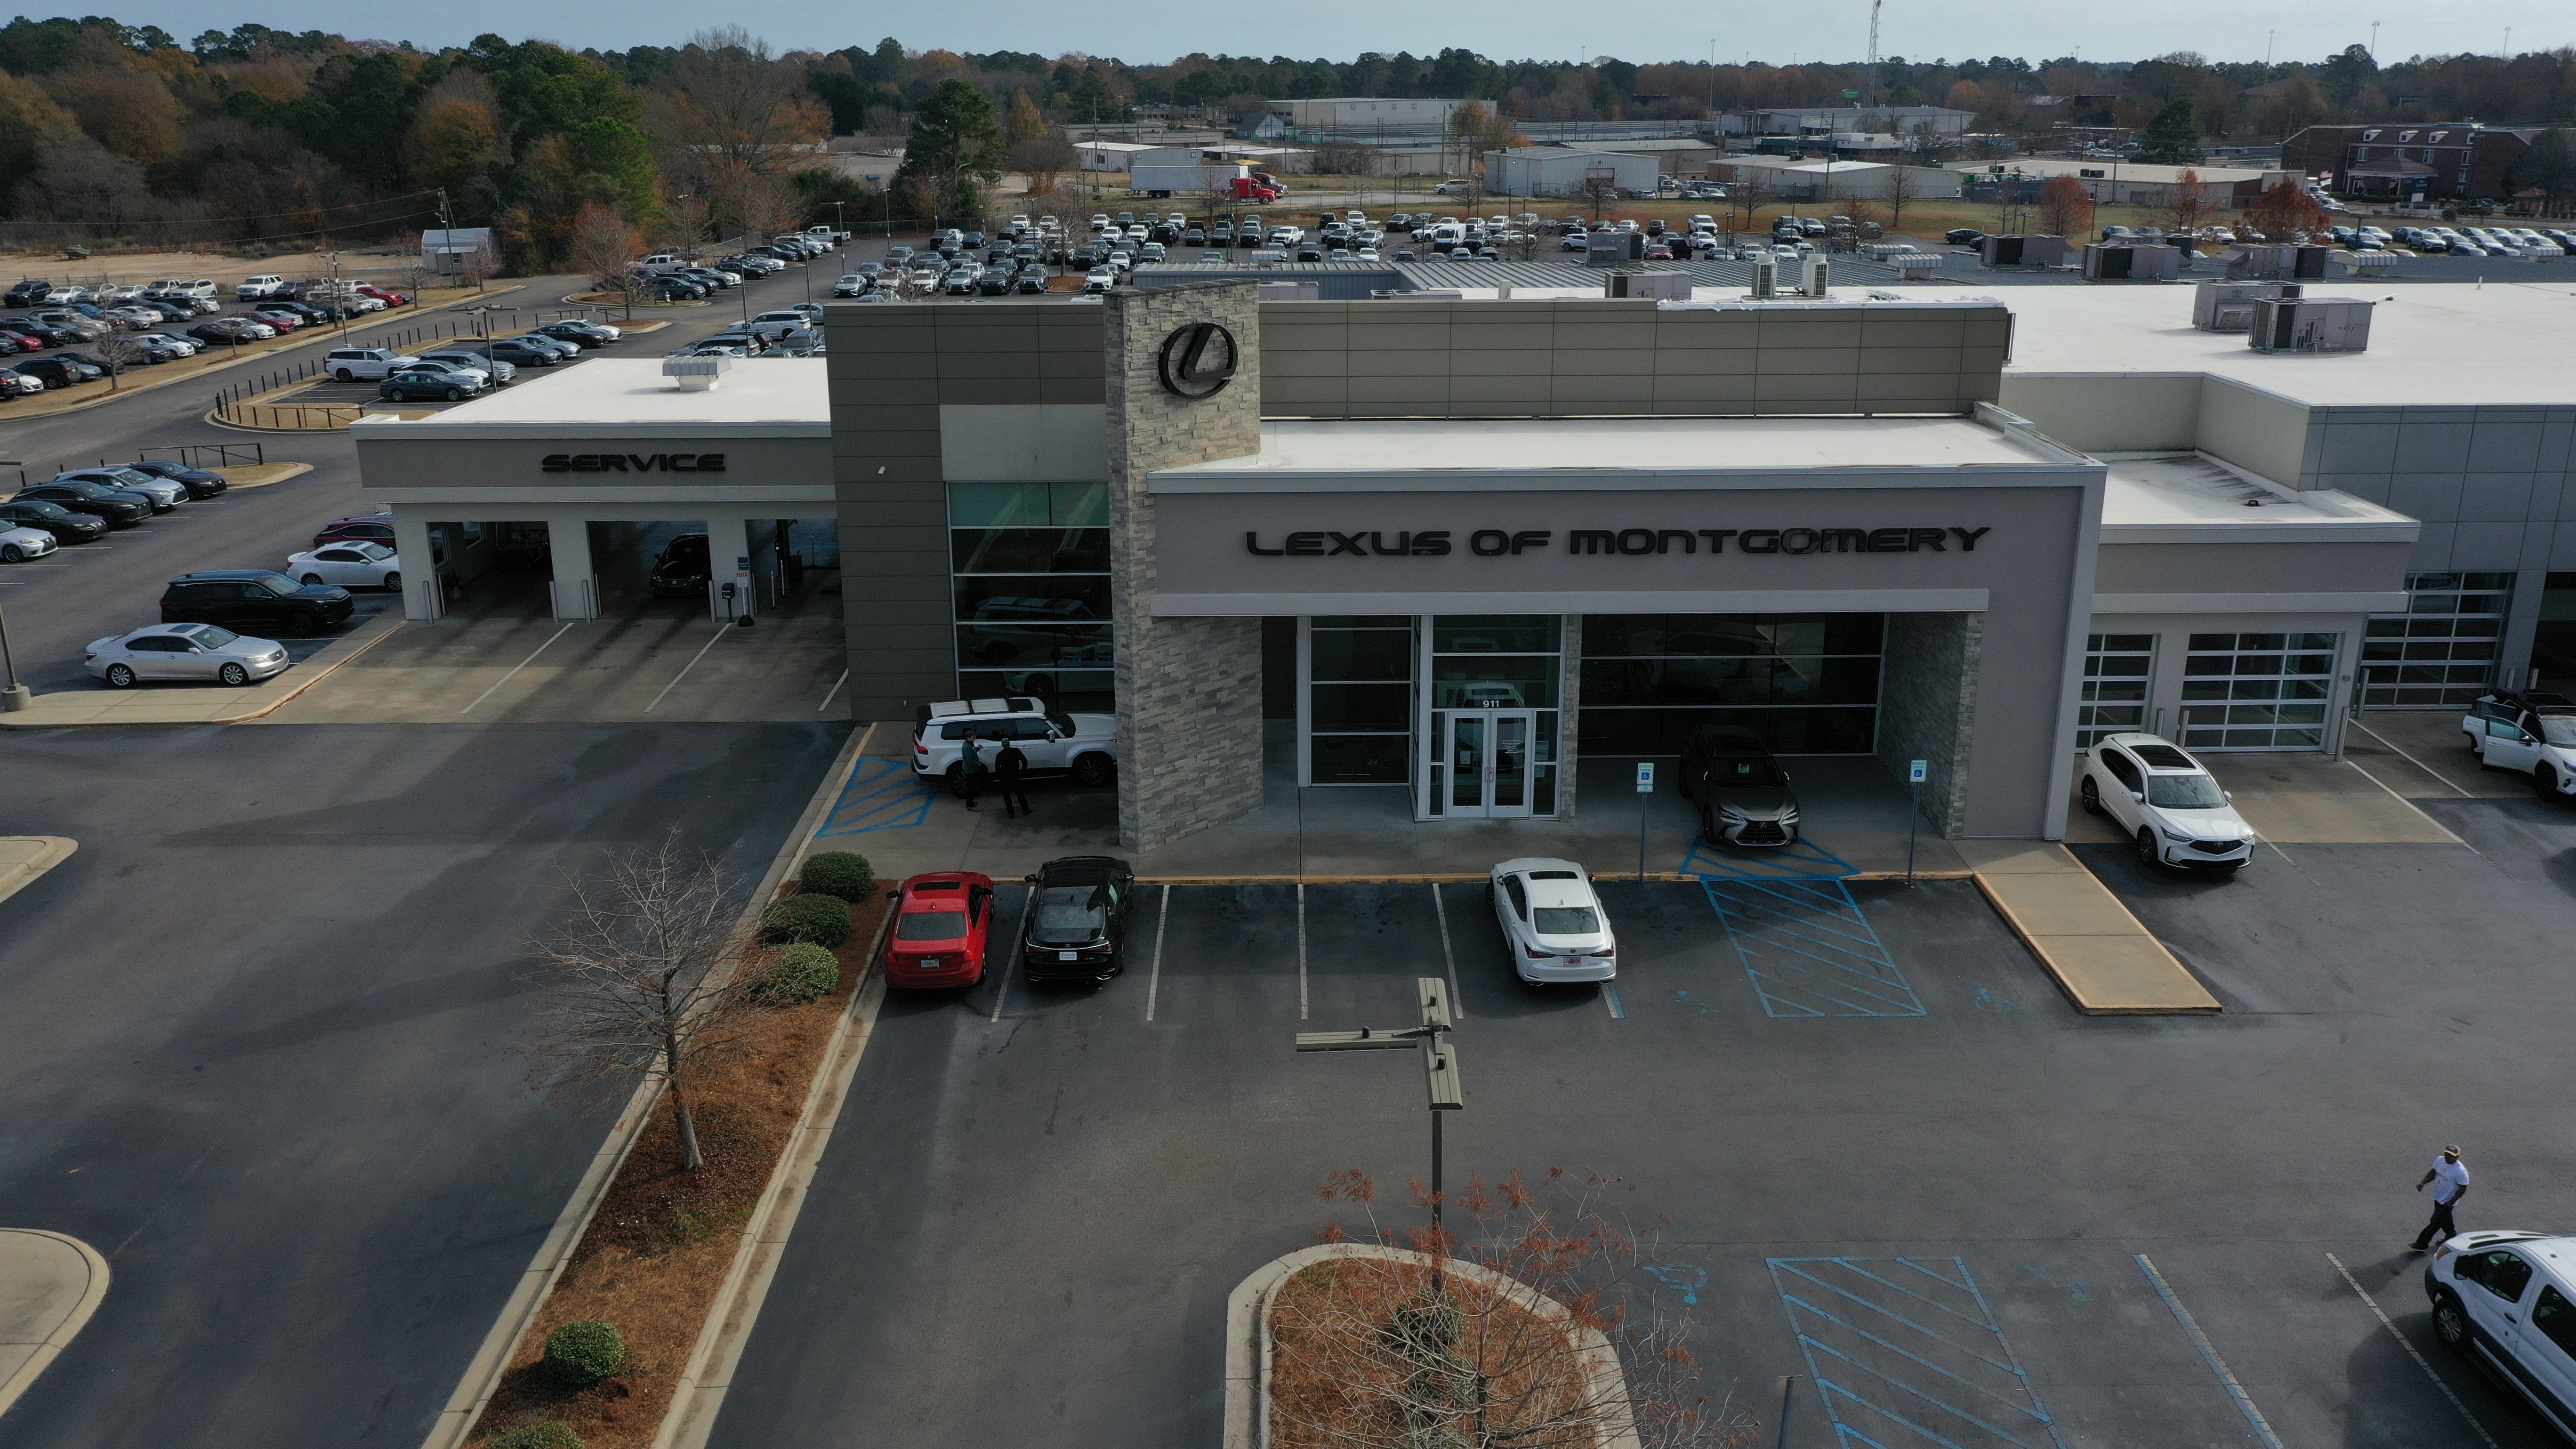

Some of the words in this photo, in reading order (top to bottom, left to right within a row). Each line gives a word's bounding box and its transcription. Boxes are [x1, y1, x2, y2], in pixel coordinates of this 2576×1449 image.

[541, 453, 725, 472] SERVICE
[1247, 531, 1451, 556] LEXUS
[1471, 529, 1551, 556] OF
[1570, 527, 1991, 555] MONTGOMERY
